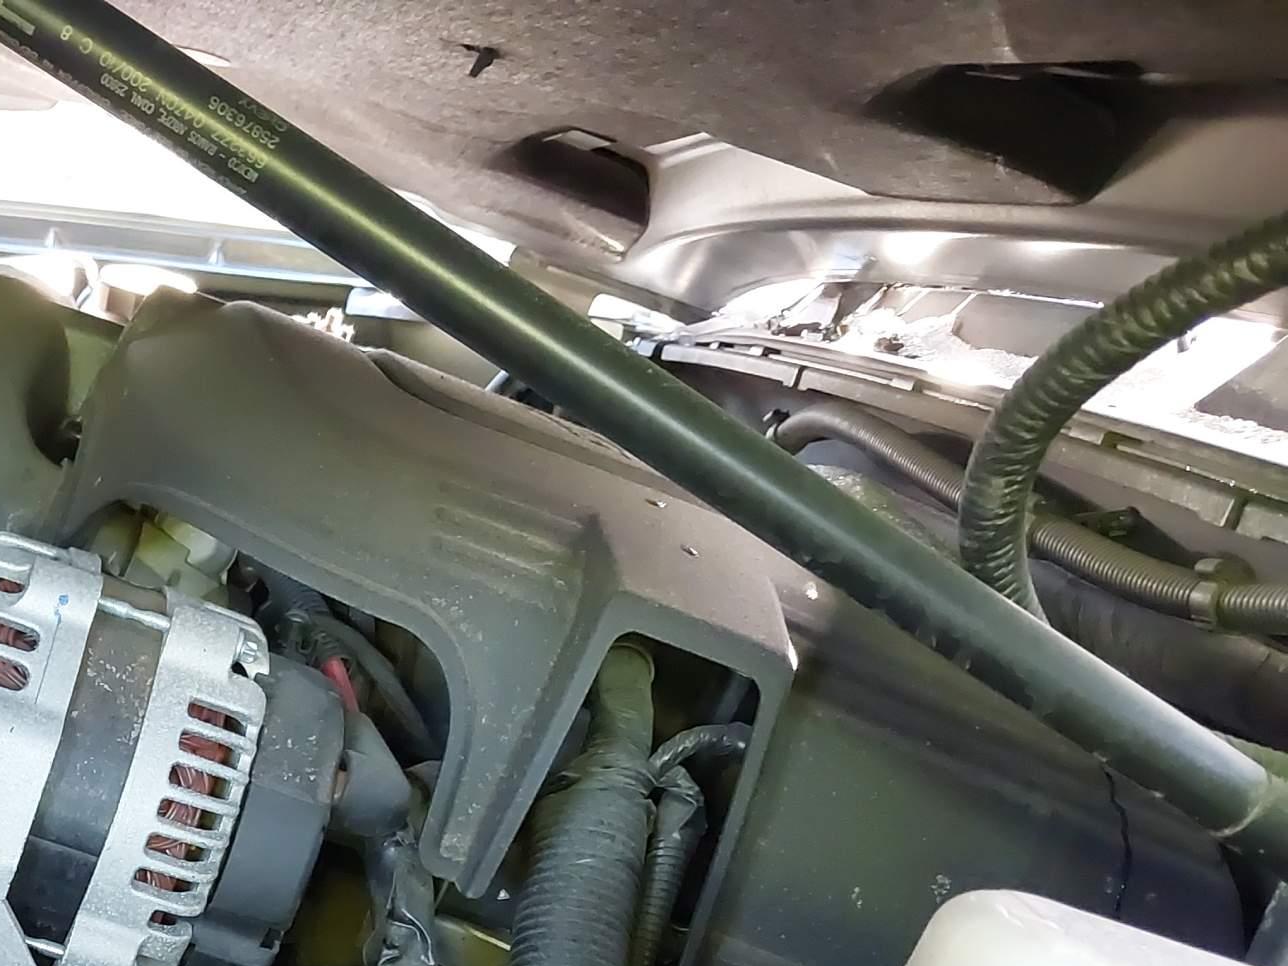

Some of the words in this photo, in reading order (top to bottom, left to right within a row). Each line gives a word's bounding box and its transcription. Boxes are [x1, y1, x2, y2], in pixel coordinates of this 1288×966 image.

[58, 24, 73, 40] 8
[77, 37, 93, 53] C
[188, 131, 217, 154] RAMOS
